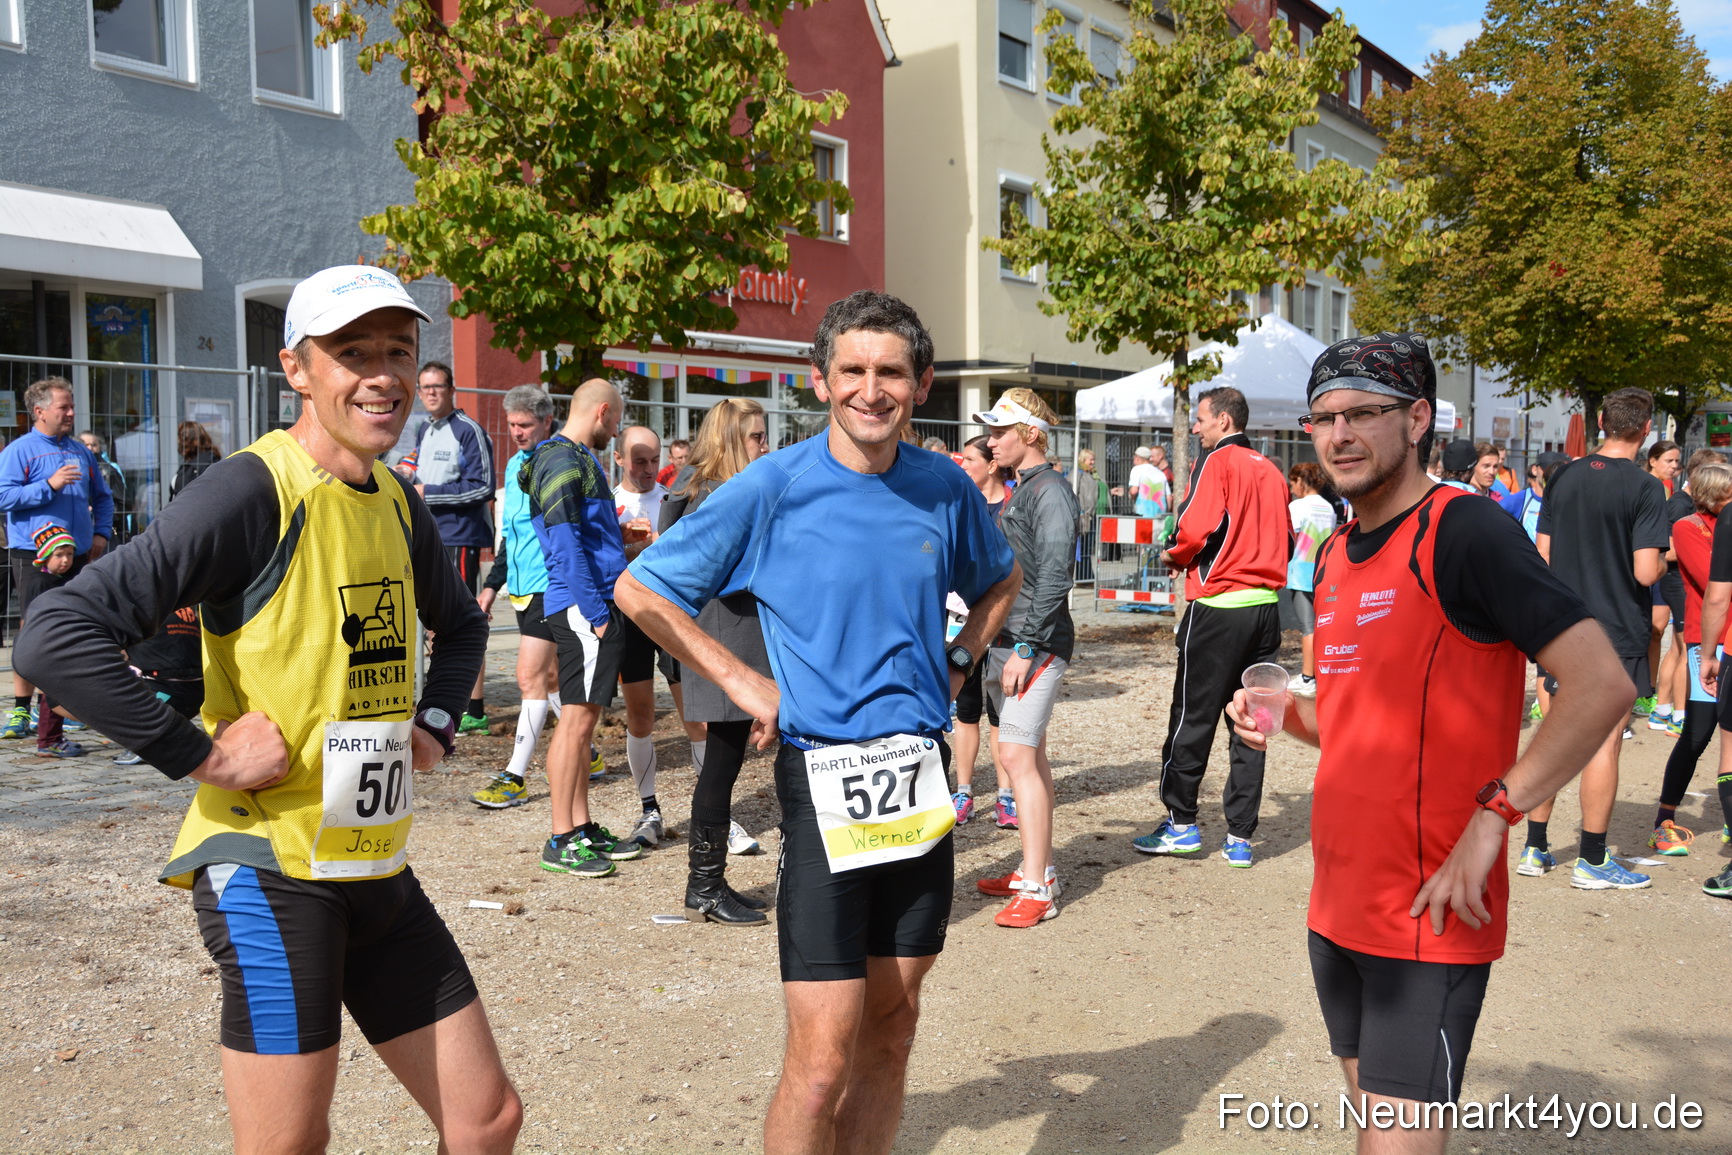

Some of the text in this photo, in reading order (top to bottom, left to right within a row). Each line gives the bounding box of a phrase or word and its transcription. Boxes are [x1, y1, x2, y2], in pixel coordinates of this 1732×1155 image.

[198, 335, 215, 352] 24
[1324, 644, 1358, 655] Gruber
[348, 665, 406, 690] HIRSCH
[349, 696, 407, 711] AOTEKE
[328, 738, 382, 752] PARTL
[810, 743, 922, 775] PARTL Neumarkt
[842, 762, 921, 820] 527
[848, 826, 925, 849] Werner
